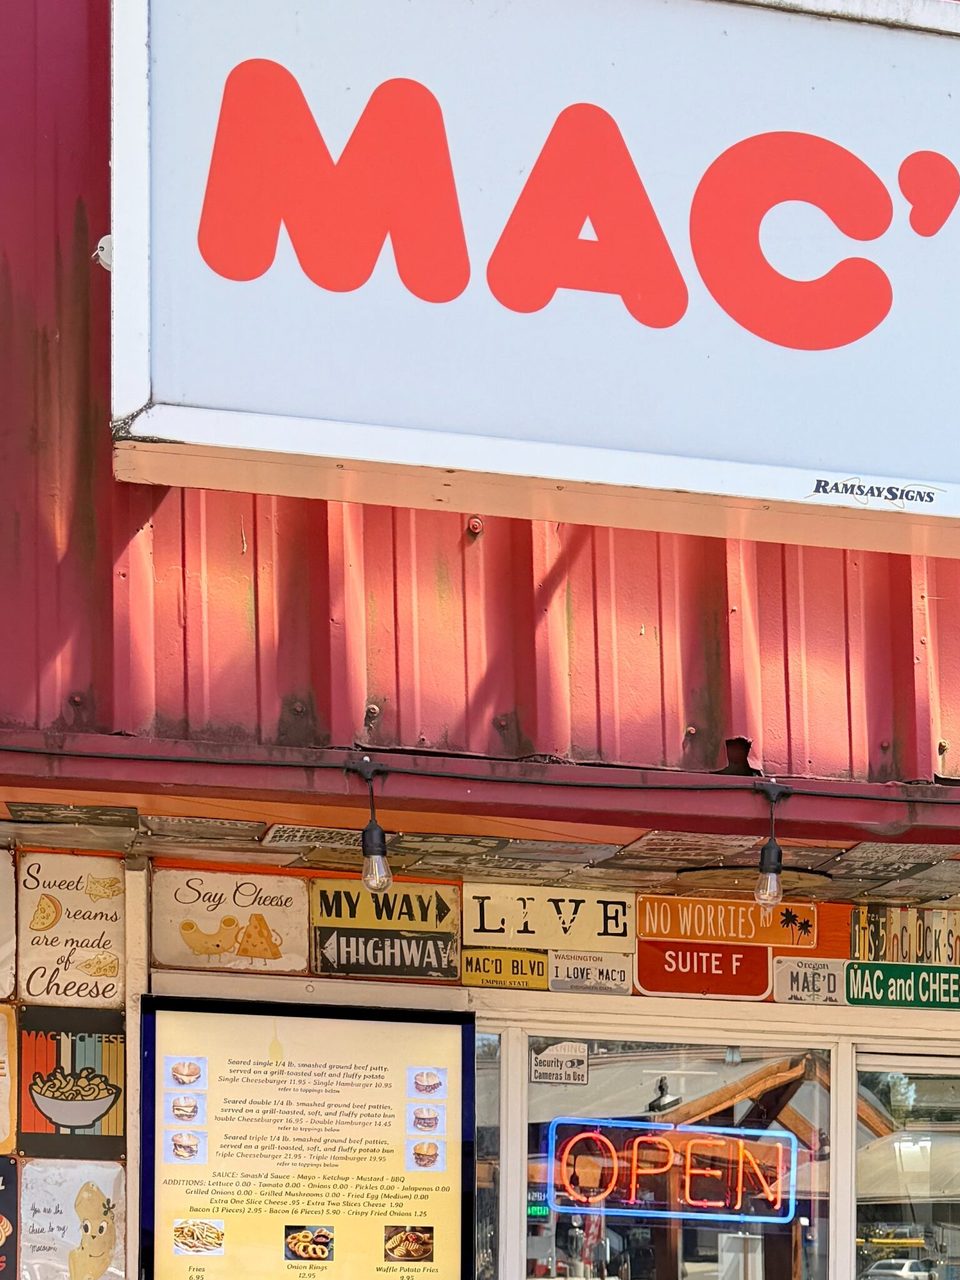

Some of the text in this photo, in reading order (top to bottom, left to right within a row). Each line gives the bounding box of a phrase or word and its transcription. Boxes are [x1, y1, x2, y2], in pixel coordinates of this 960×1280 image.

[22, 862, 83, 892] Sweet
[175, 878, 292, 911] Say Cheese
[319, 891, 432, 921] MY WAY
[646, 903, 772, 938] NO WORRIES RD
[31, 933, 112, 949] are made
[56, 949, 75, 972] of
[340, 937, 451, 969] HIGHWAY
[665, 951, 743, 974] SUITE F
[465, 957, 544, 976] MAC'D BLVD
[555, 967, 626, 981] I LOVE MAC'D
[26, 967, 117, 999] Cheese
[791, 972, 836, 992] MAC'D
[850, 969, 884, 999] MAC
[888, 977, 914, 1001] and
[534, 1057, 563, 1069] Security
[534, 1069, 562, 1081] Cameras
[562, 1132, 783, 1210] OPEN
[309, 1264, 328, 1272] Rings
